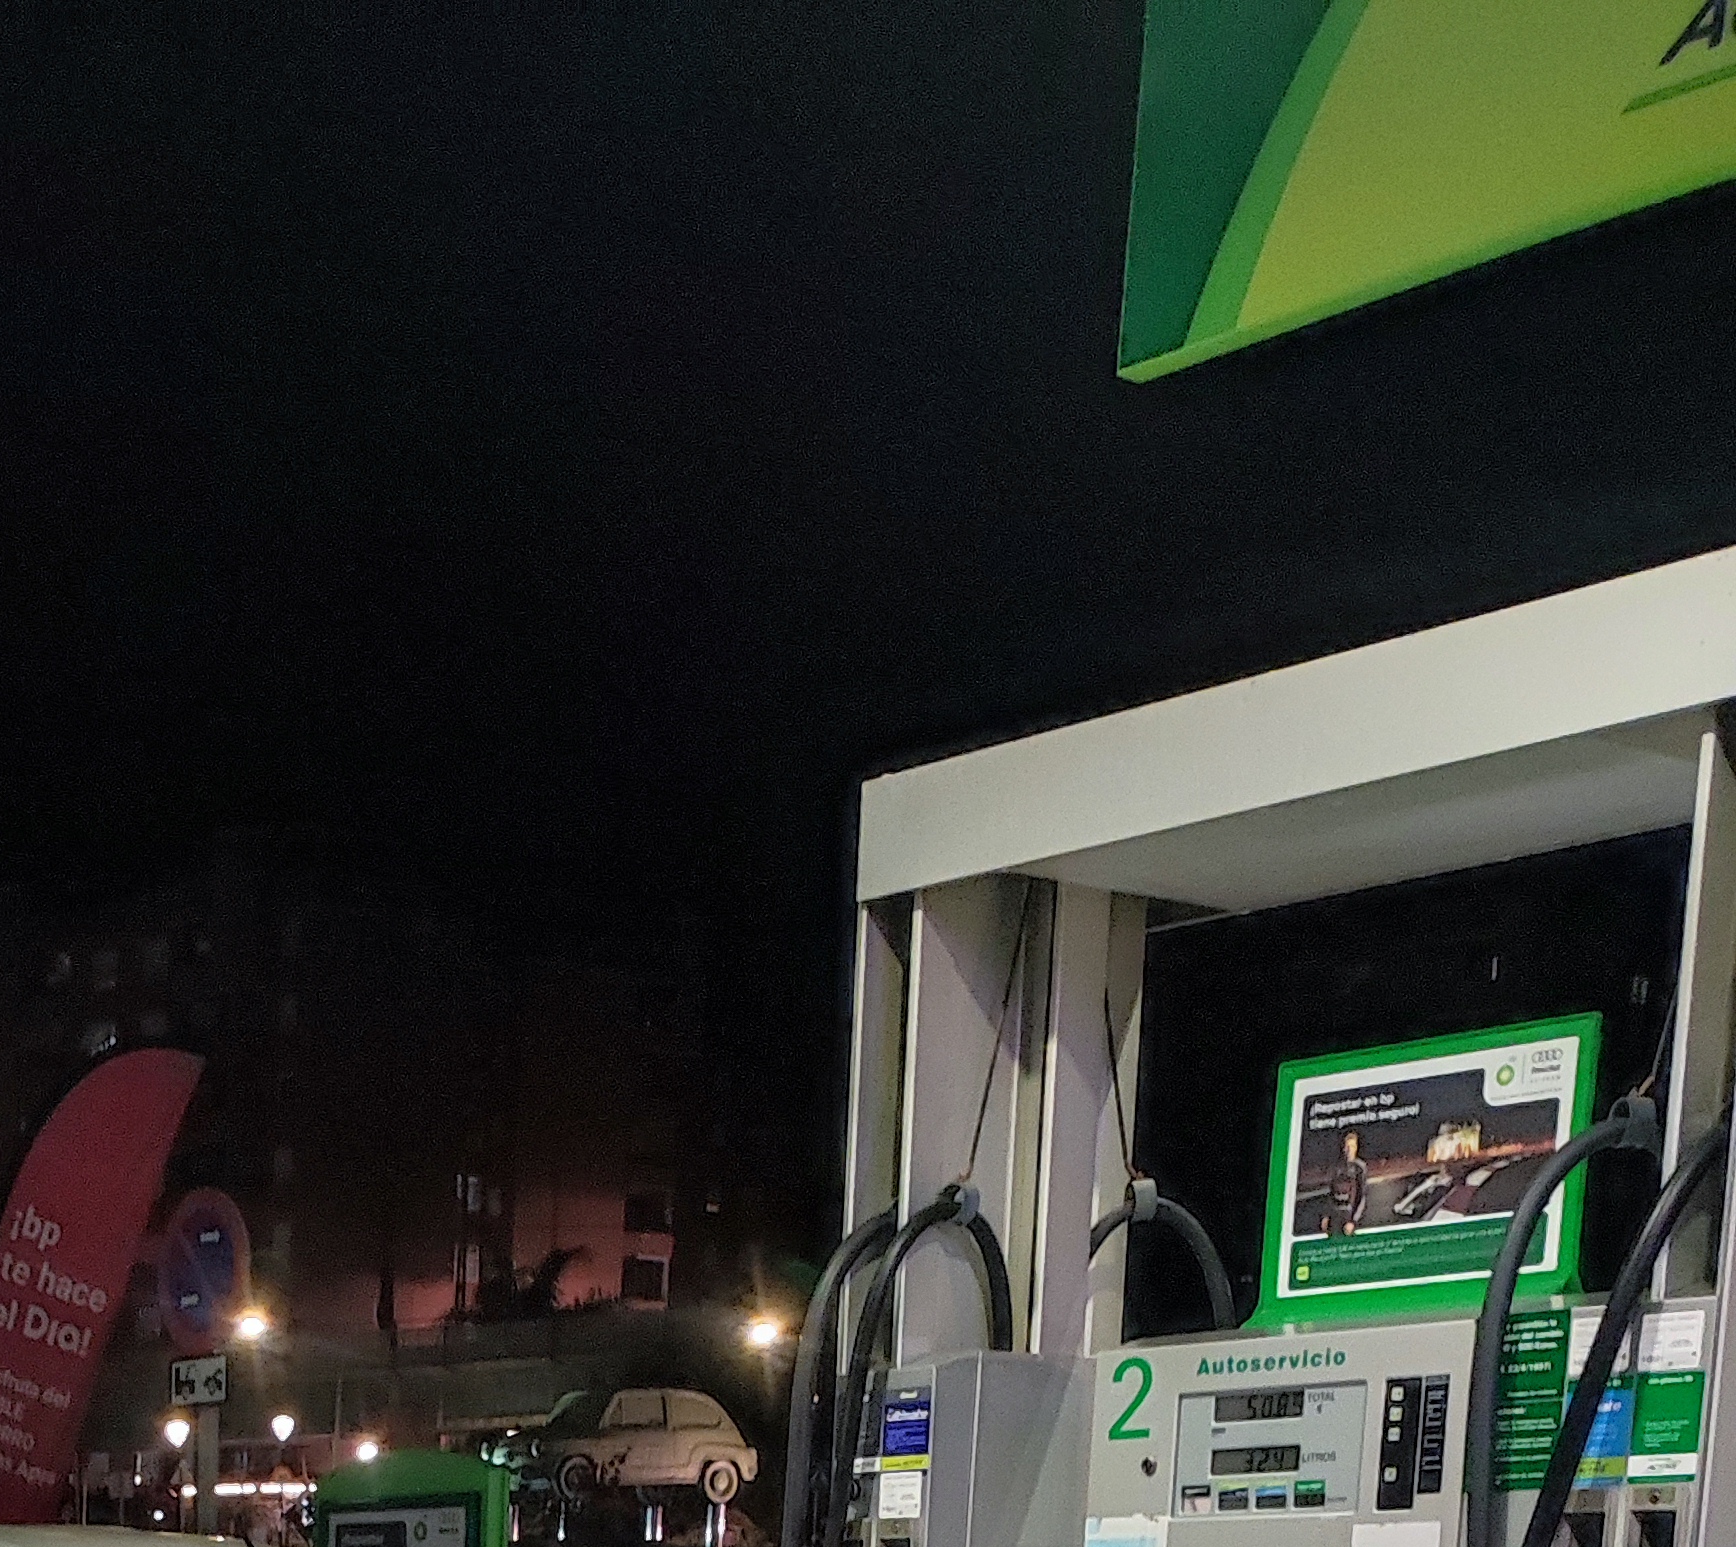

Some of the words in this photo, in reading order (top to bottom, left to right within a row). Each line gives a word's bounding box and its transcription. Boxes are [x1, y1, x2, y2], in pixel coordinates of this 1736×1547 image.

[0, 1251, 32, 1285] te
[36, 1260, 108, 1313] hace
[1195, 1348, 1347, 1377] Autoservicio
[1108, 1356, 1153, 1440] 2
[1307, 1391, 1336, 1403] TOTAL
